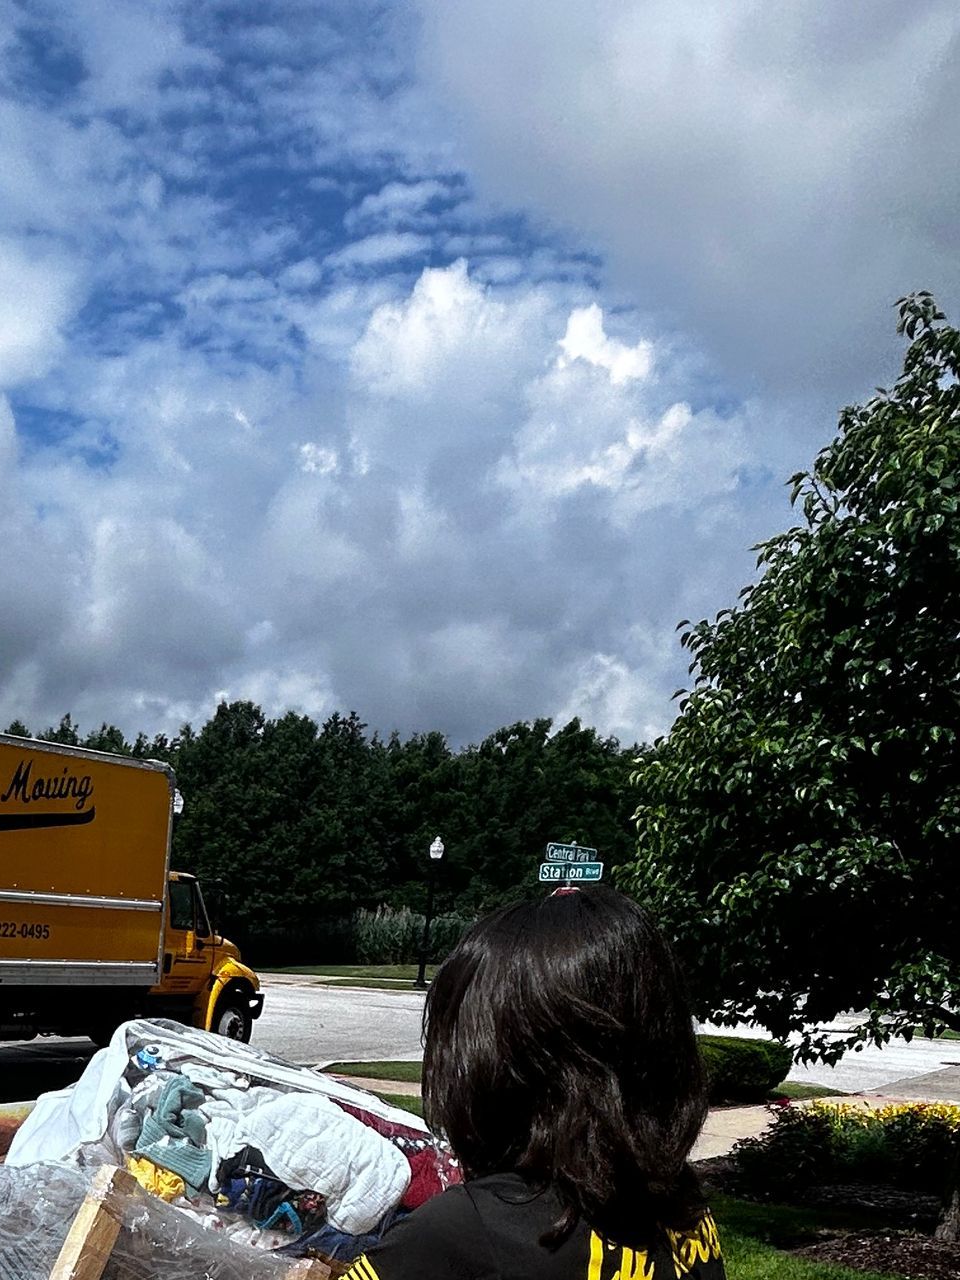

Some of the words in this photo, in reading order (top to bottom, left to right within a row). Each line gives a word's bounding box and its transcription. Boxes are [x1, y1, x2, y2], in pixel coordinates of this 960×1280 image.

[0, 760, 94, 809] Moving
[548, 846, 576, 861] Central
[542, 866, 583, 878] Station
